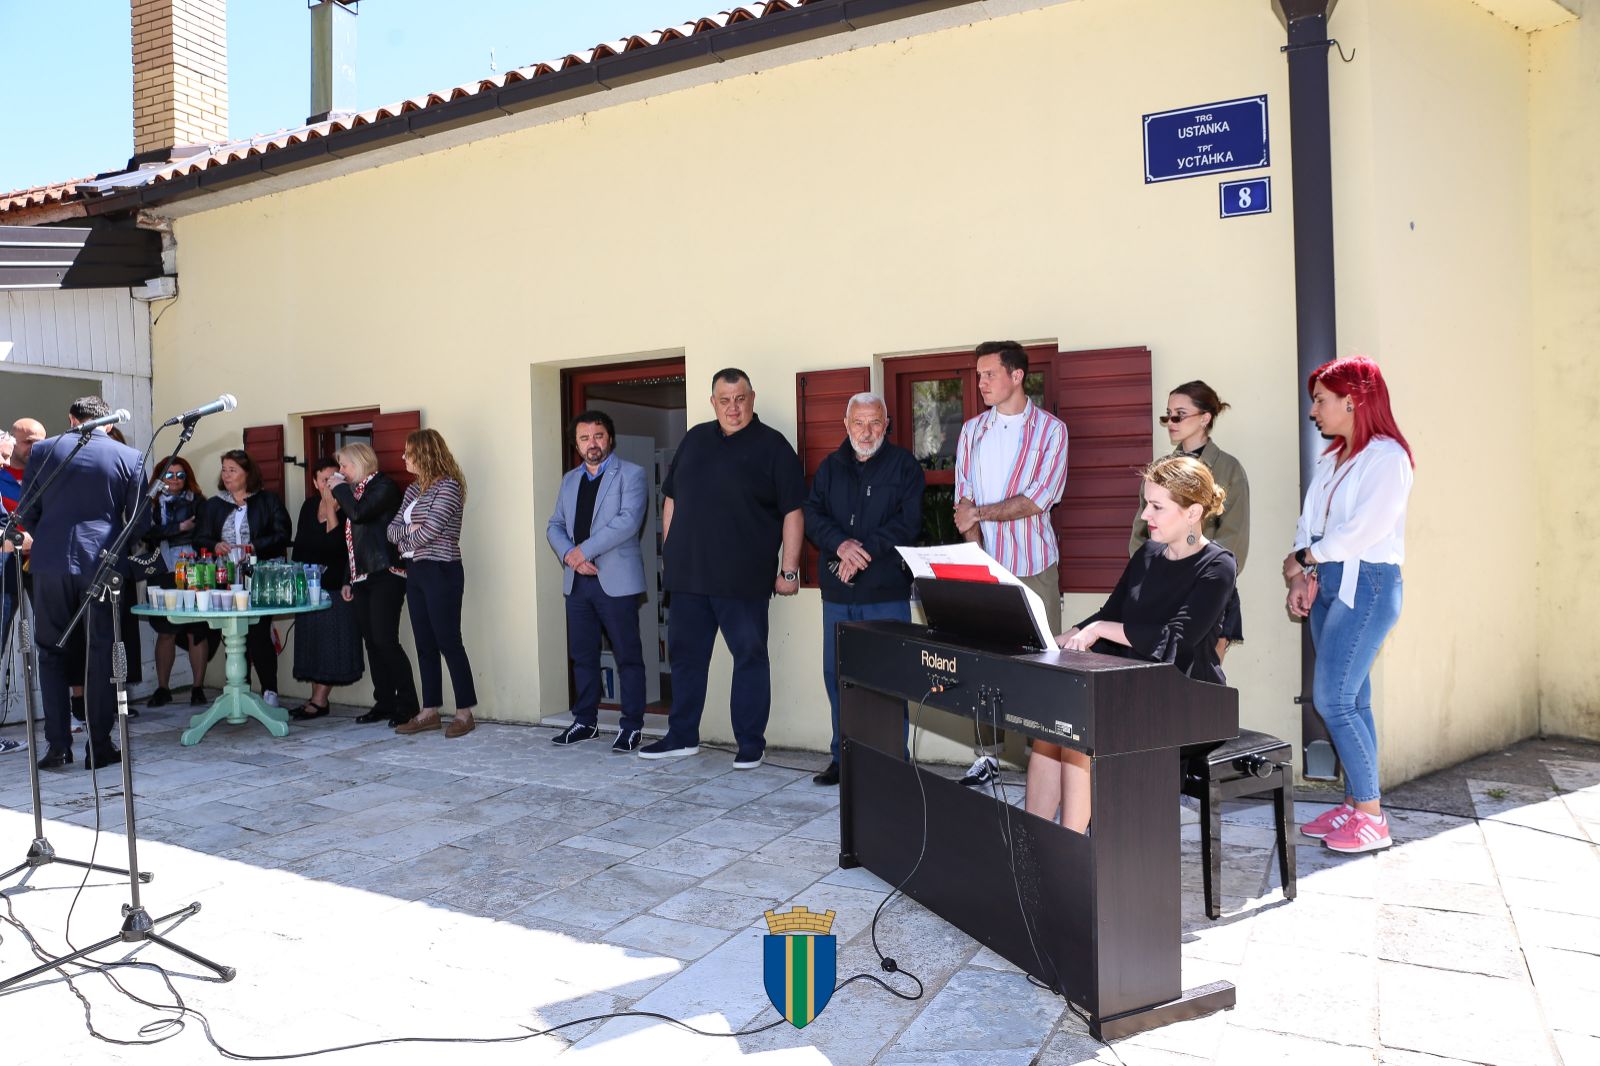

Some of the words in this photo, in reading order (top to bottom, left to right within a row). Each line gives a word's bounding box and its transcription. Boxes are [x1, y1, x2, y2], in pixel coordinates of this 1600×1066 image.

[1195, 113, 1213, 123] TRG
[1178, 121, 1230, 139] USTANKA
[1197, 144, 1213, 153] ТРГ
[1177, 151, 1234, 169] УСТАНКА
[1238, 187, 1251, 208] 8
[921, 649, 957, 673] Roland
